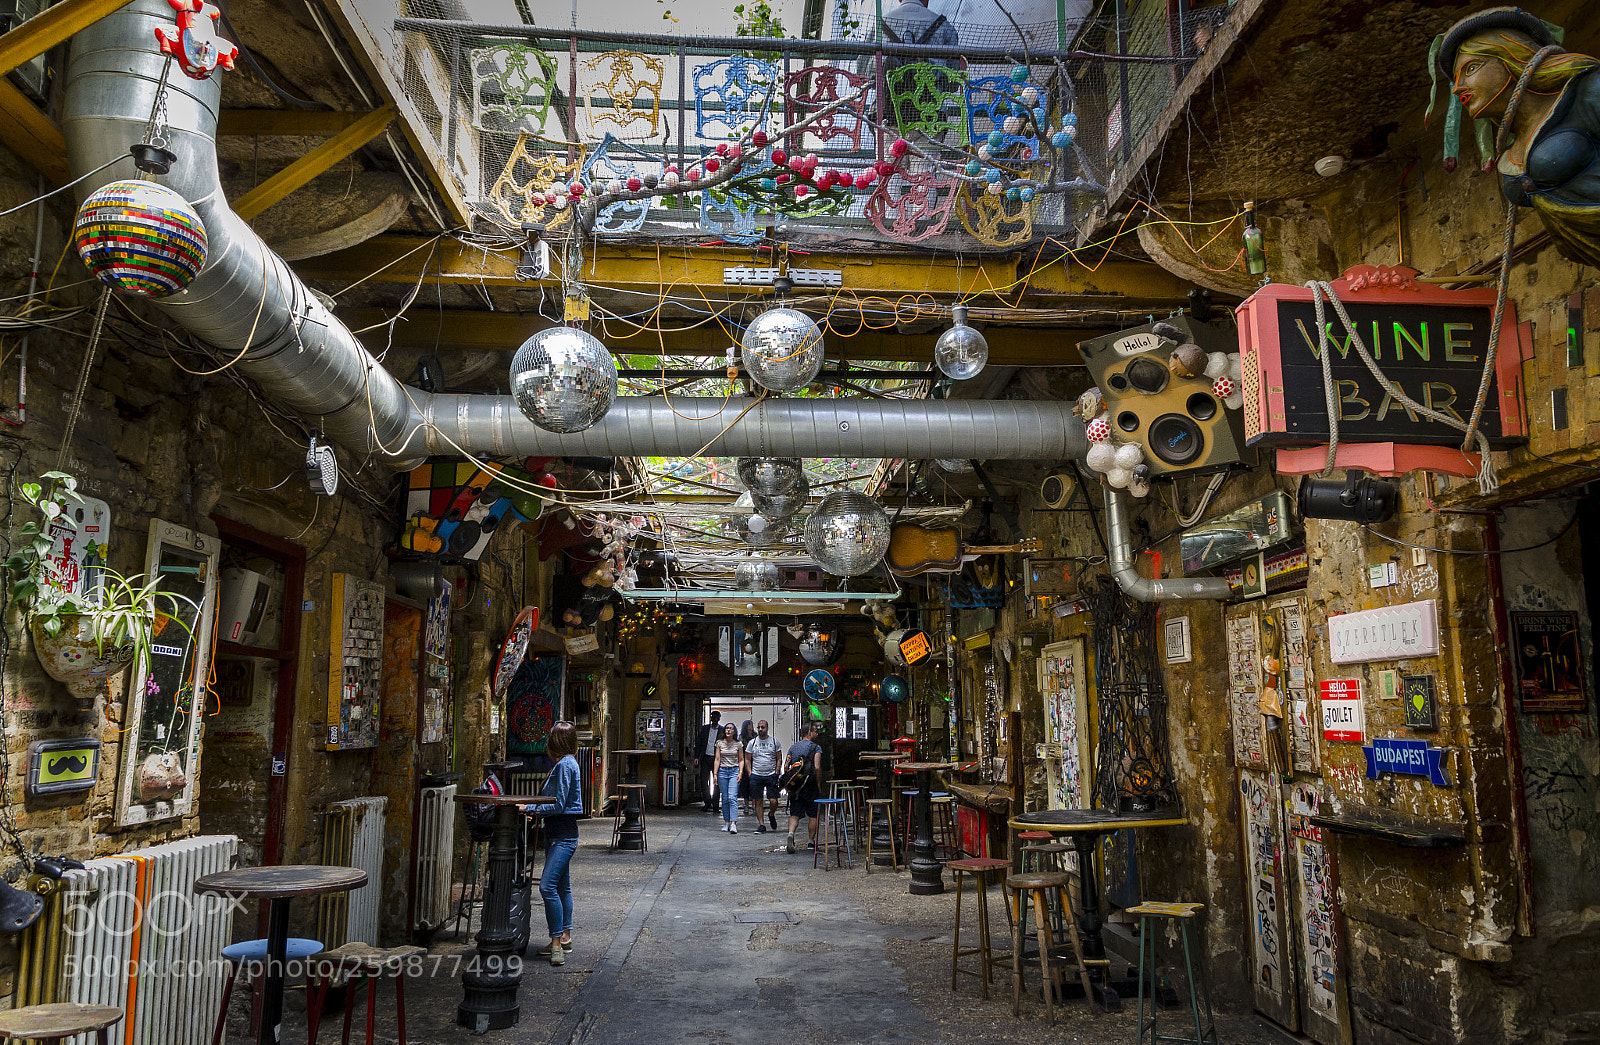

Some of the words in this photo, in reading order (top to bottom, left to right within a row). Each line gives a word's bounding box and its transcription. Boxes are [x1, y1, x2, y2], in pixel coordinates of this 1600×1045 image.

[1123, 336, 1153, 352] Hello!
[1295, 319, 1479, 362] WINE
[1333, 379, 1465, 423] BAR
[1518, 616, 1546, 625] DRINK
[1548, 616, 1571, 624] WINE
[1523, 624, 1545, 632] FEEL
[1546, 624, 1568, 632] FINE
[1329, 682, 1347, 692] HELLO
[1327, 706, 1353, 723] TOILET
[1375, 747, 1425, 765] BUDAPEST
